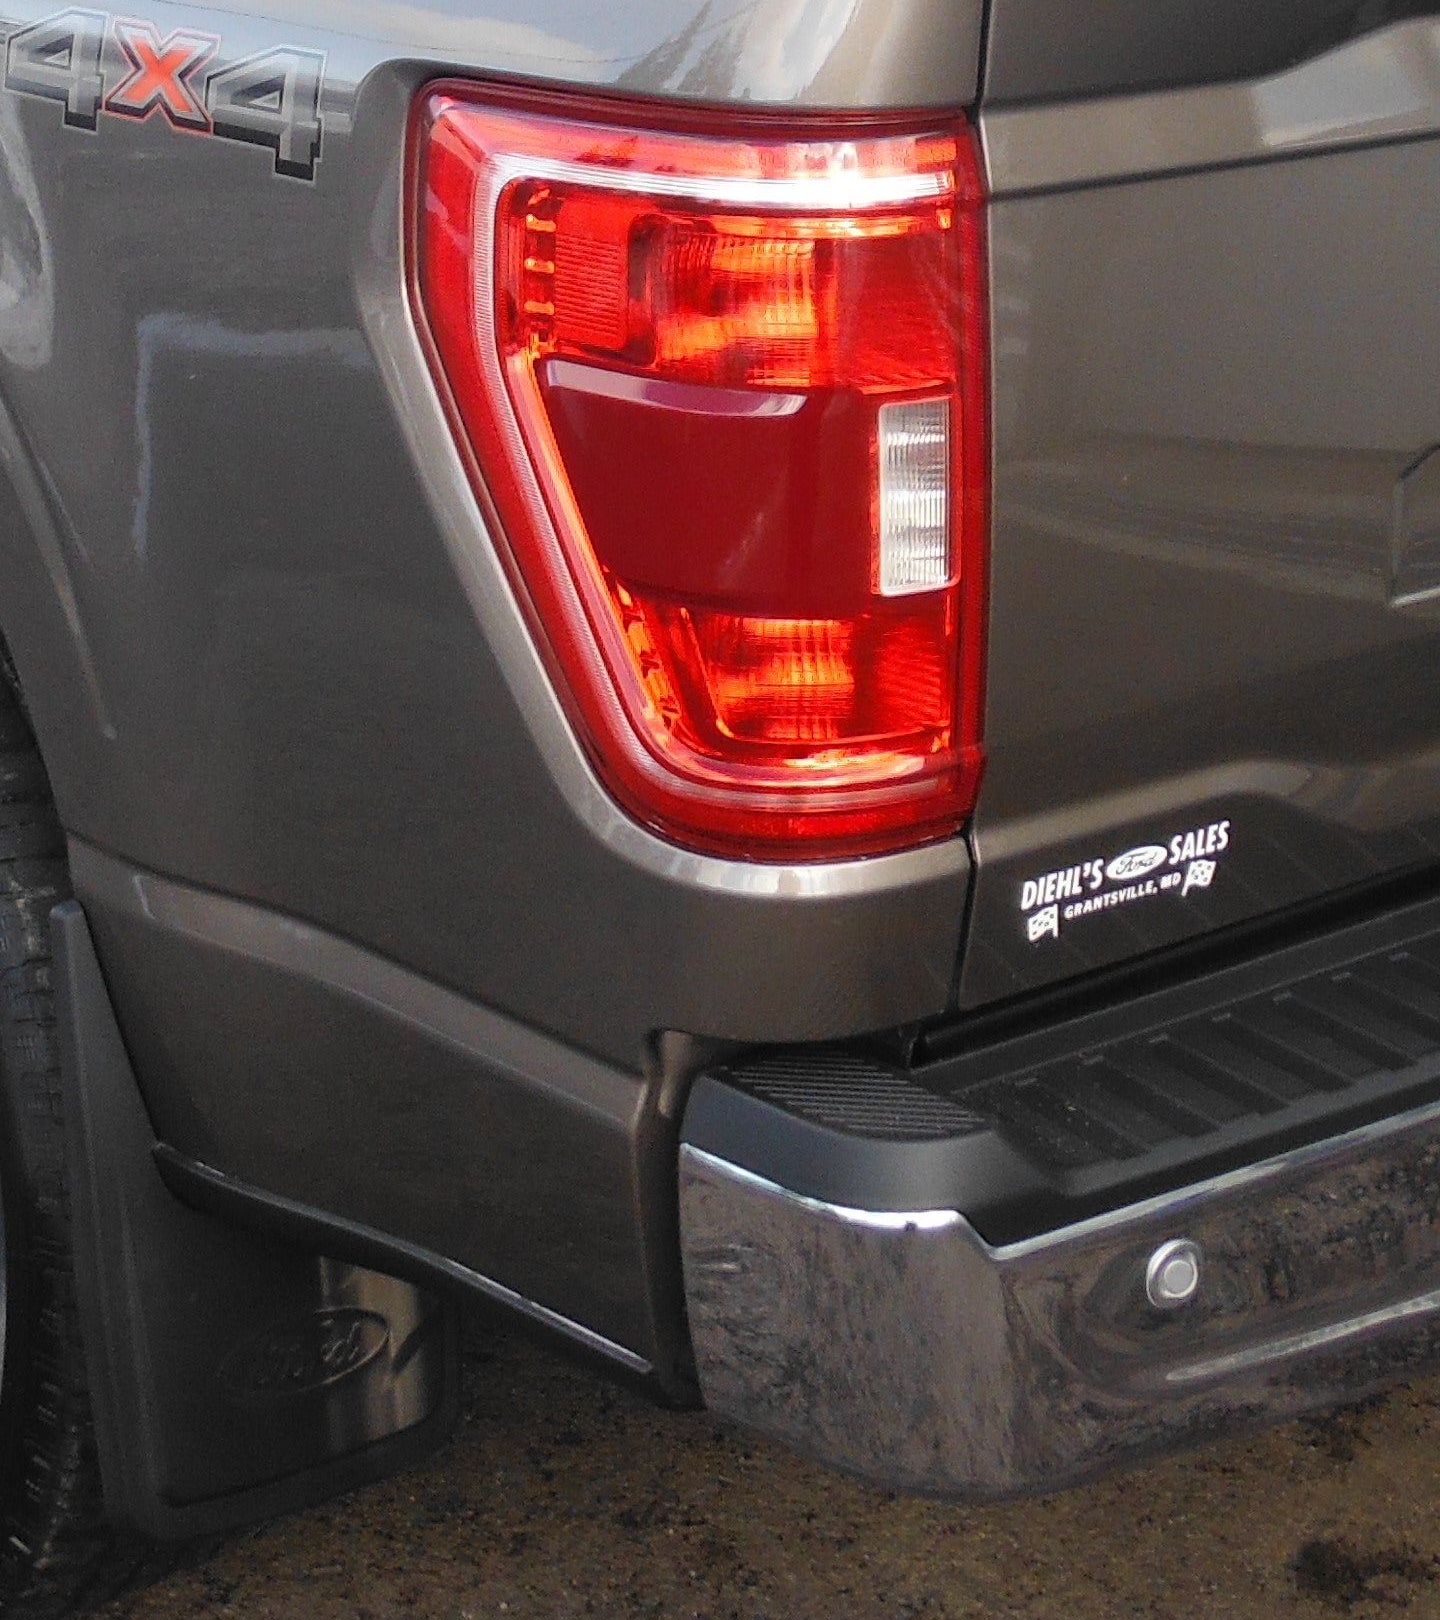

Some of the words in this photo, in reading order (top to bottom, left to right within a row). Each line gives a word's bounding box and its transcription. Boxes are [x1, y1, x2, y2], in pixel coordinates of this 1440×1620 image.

[1021, 858, 1106, 910] DIEHL'S
[1168, 820, 1231, 865] SALES
[1064, 880, 1158, 919] GRANTSVILLE,
